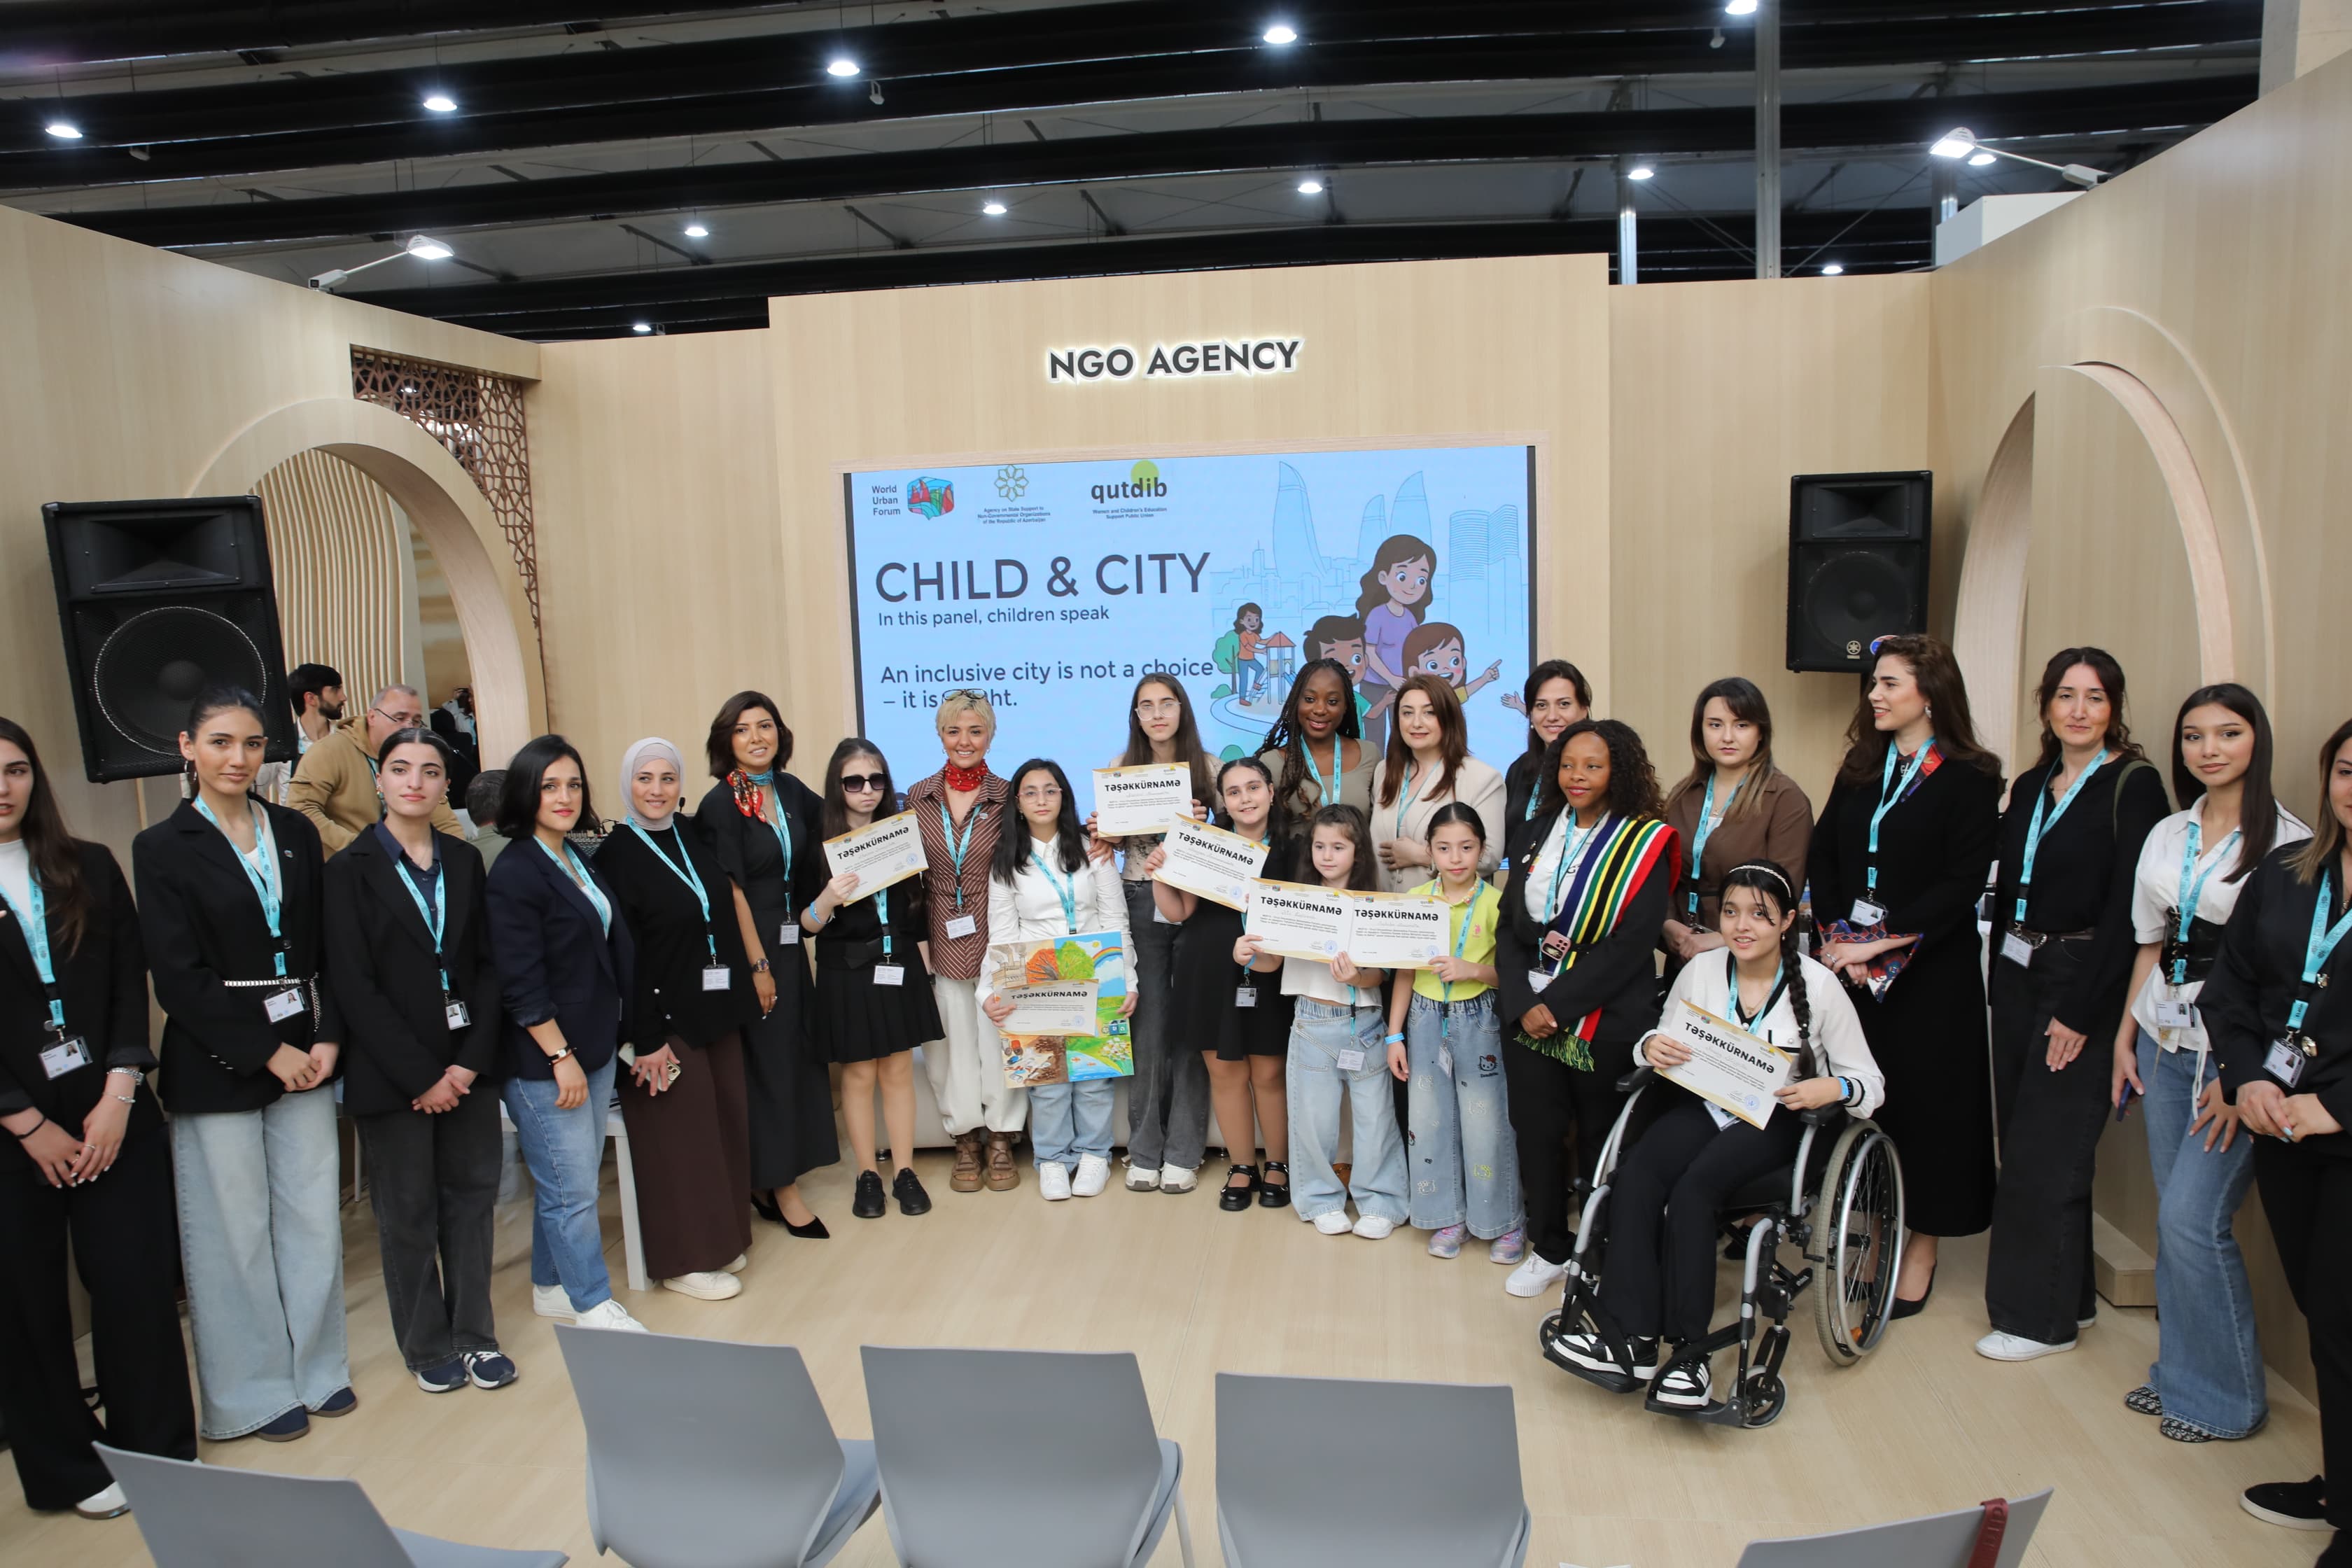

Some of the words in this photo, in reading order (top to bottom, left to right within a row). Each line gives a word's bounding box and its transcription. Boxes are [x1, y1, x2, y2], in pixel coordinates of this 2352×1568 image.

[1050, 349, 1134, 379] NGO
[1147, 340, 1299, 374] AGENCY
[872, 485, 897, 494] World
[872, 496, 898, 505] Urban
[1091, 477, 1168, 504] qutdib
[873, 507, 901, 516] Forum
[876, 559, 1029, 603] CHILD
[1046, 556, 1079, 598] &
[1096, 552, 1210, 596] CITY
[878, 612, 893, 626] In
[898, 610, 928, 626] this
[932, 609, 982, 628] panel,
[987, 607, 1055, 624] children
[1060, 605, 1110, 623] speak
[881, 666, 909, 684] An
[915, 663, 1007, 683] inclusive
[1012, 662, 1051, 685] city
[1057, 661, 1074, 680] is
[1080, 660, 1116, 678] not
[1123, 663, 1135, 678] a
[1142, 658, 1214, 677] choice
[902, 690, 917, 708] it
[923, 690, 939, 708] is
[1104, 779, 1182, 792] TƏŞƏKKÜRNAMƏ
[836, 826, 909, 860] TƏŞƏKKÜRNAMƏ
[1178, 832, 1254, 866] TƏŞƏKKÜRNAMƏ
[1261, 896, 1343, 916] TƏŞƏKKÜRNAMƏ
[1354, 909, 1439, 921] TƏŞƏKKÜRNAMƏ
[1685, 1021, 1776, 1074] TƏŞƏKKÜRNAMƏ
